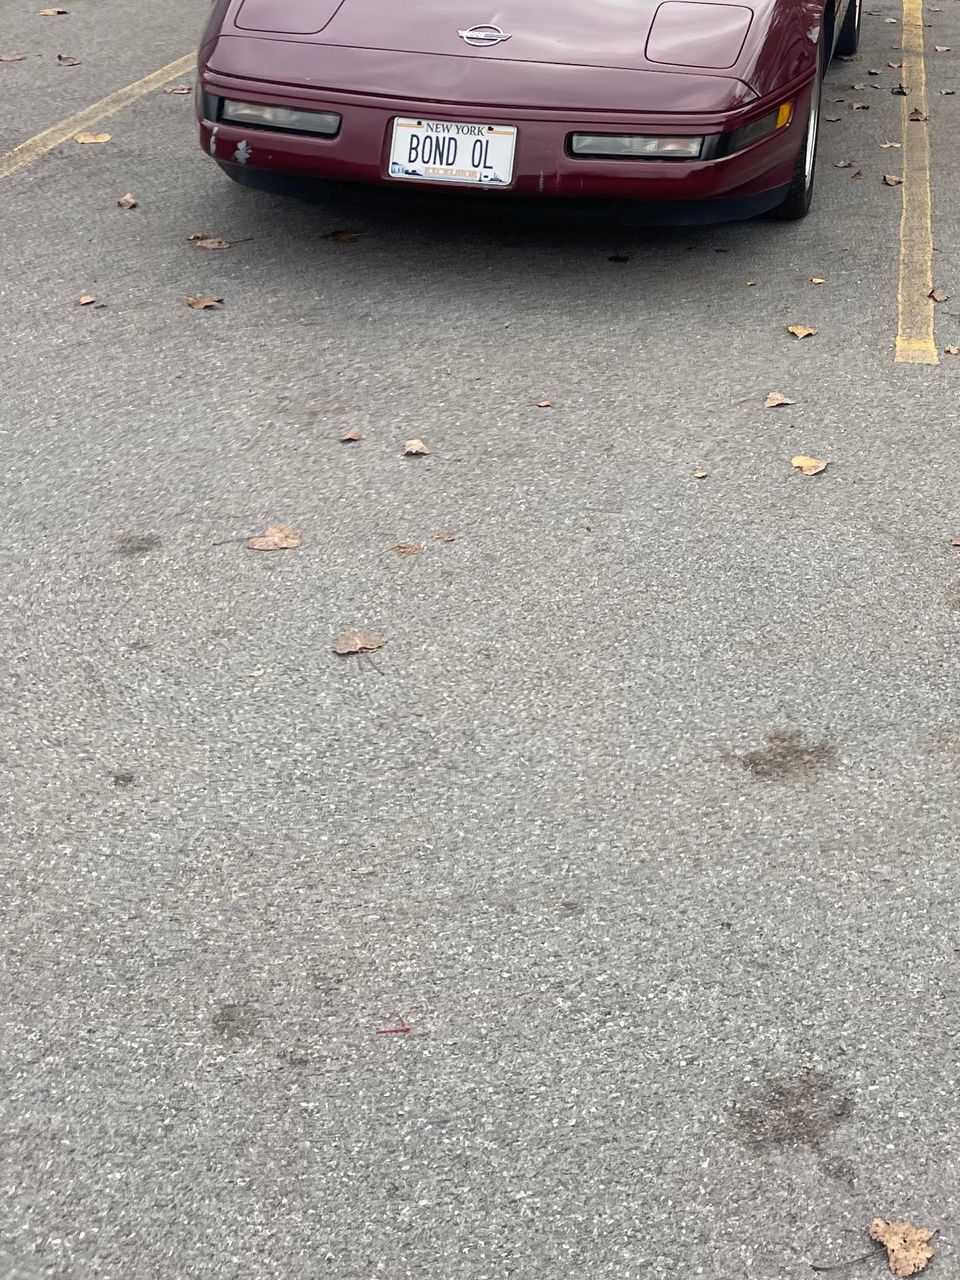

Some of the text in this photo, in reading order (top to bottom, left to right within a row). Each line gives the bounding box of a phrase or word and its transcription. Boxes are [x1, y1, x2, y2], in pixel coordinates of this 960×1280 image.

[426, 122, 485, 137] NEW YORK
[408, 134, 457, 166] BOND
